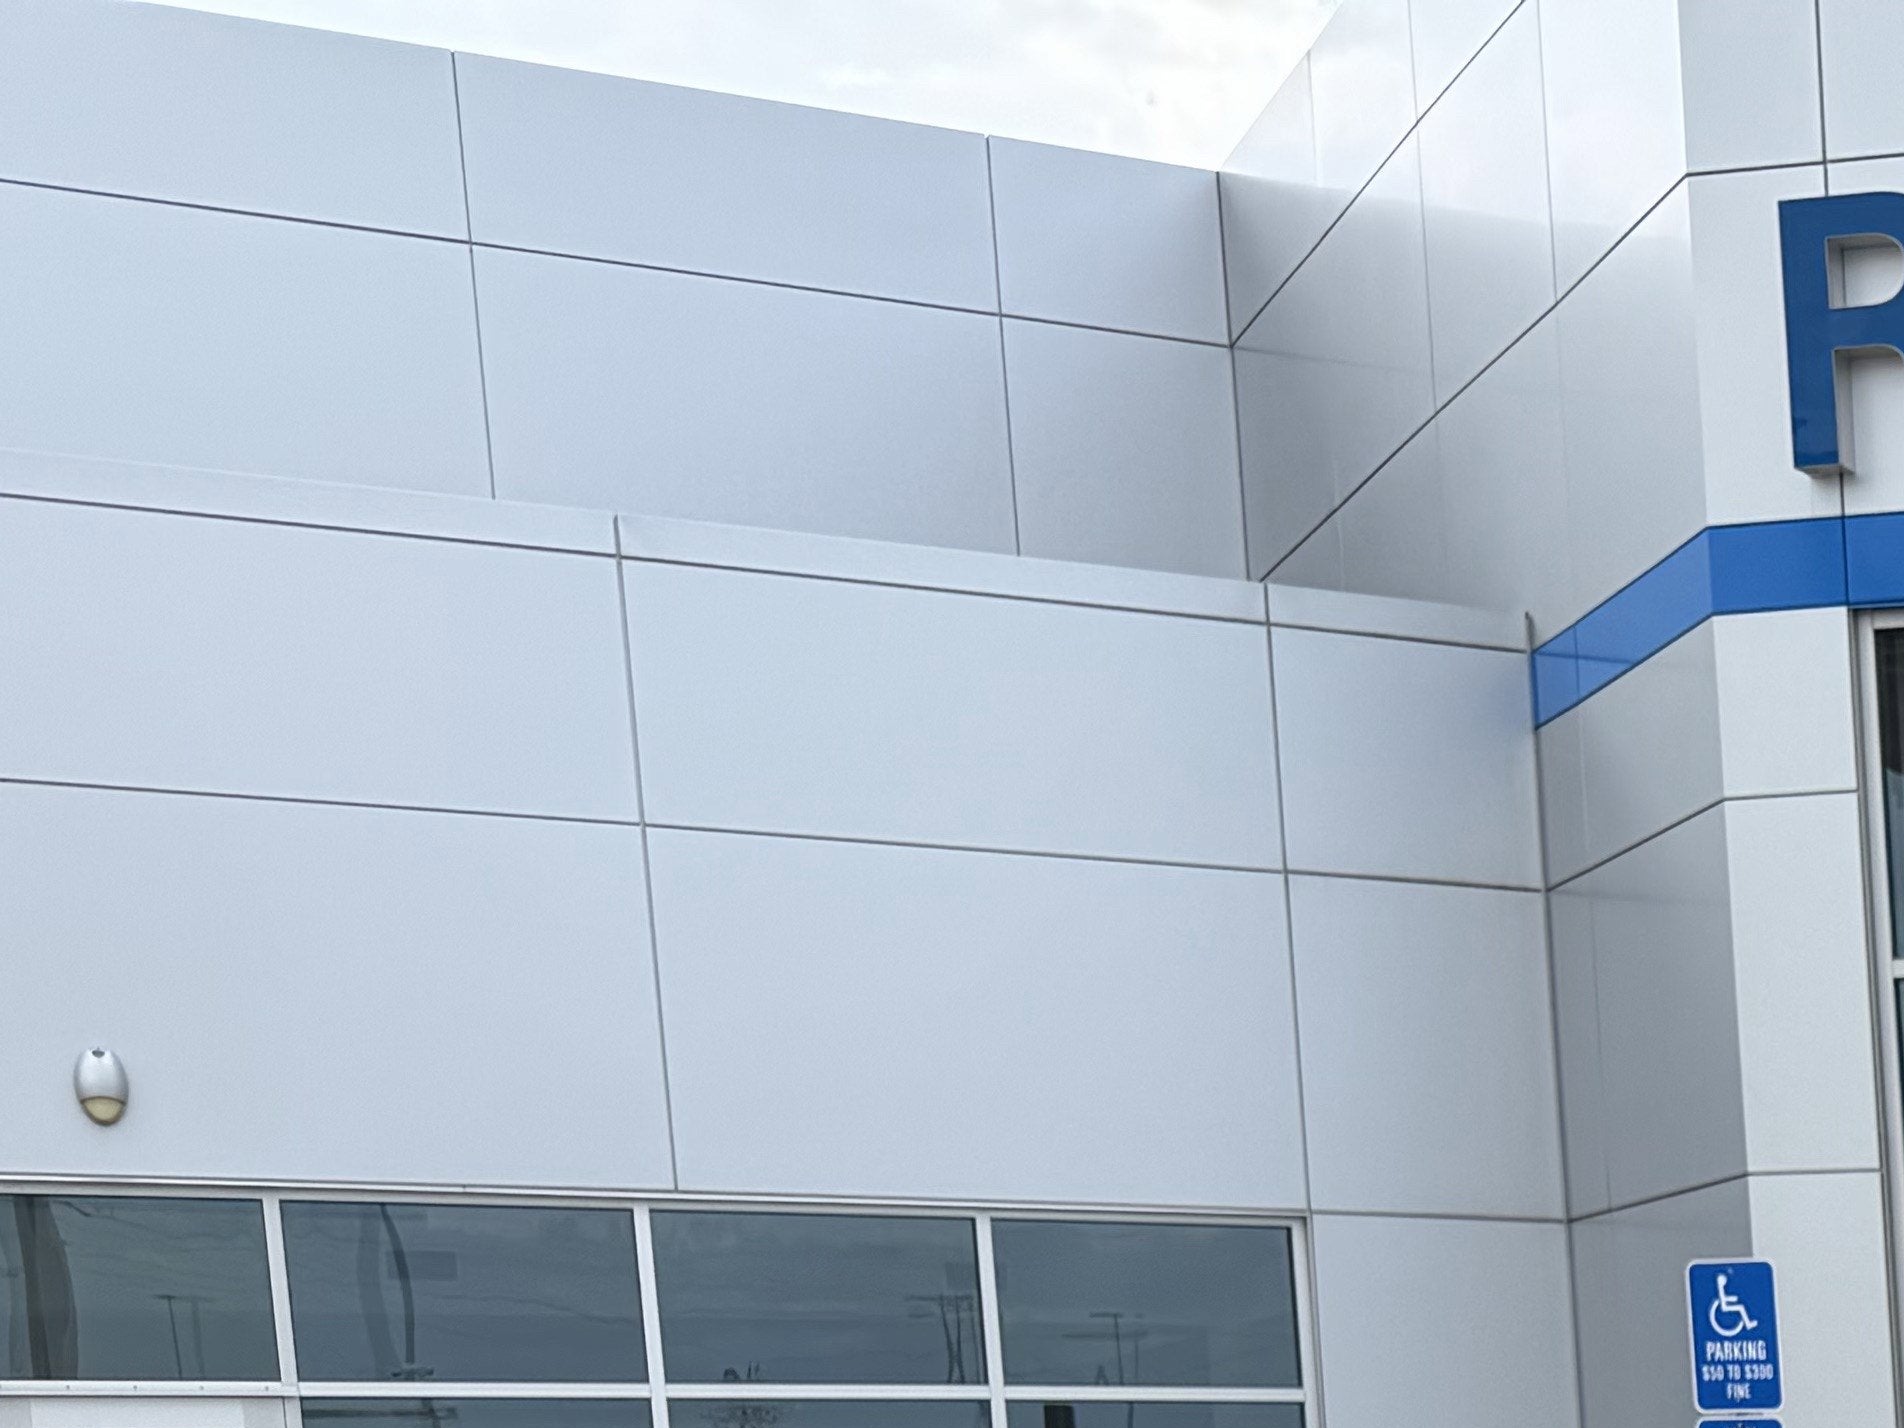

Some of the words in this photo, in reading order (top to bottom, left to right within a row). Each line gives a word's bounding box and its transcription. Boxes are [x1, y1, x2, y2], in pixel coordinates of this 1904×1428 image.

[1706, 1340, 1767, 1362] PARKING
[1727, 1364, 1742, 1380] TO
[1727, 1383, 1751, 1400] FINE
